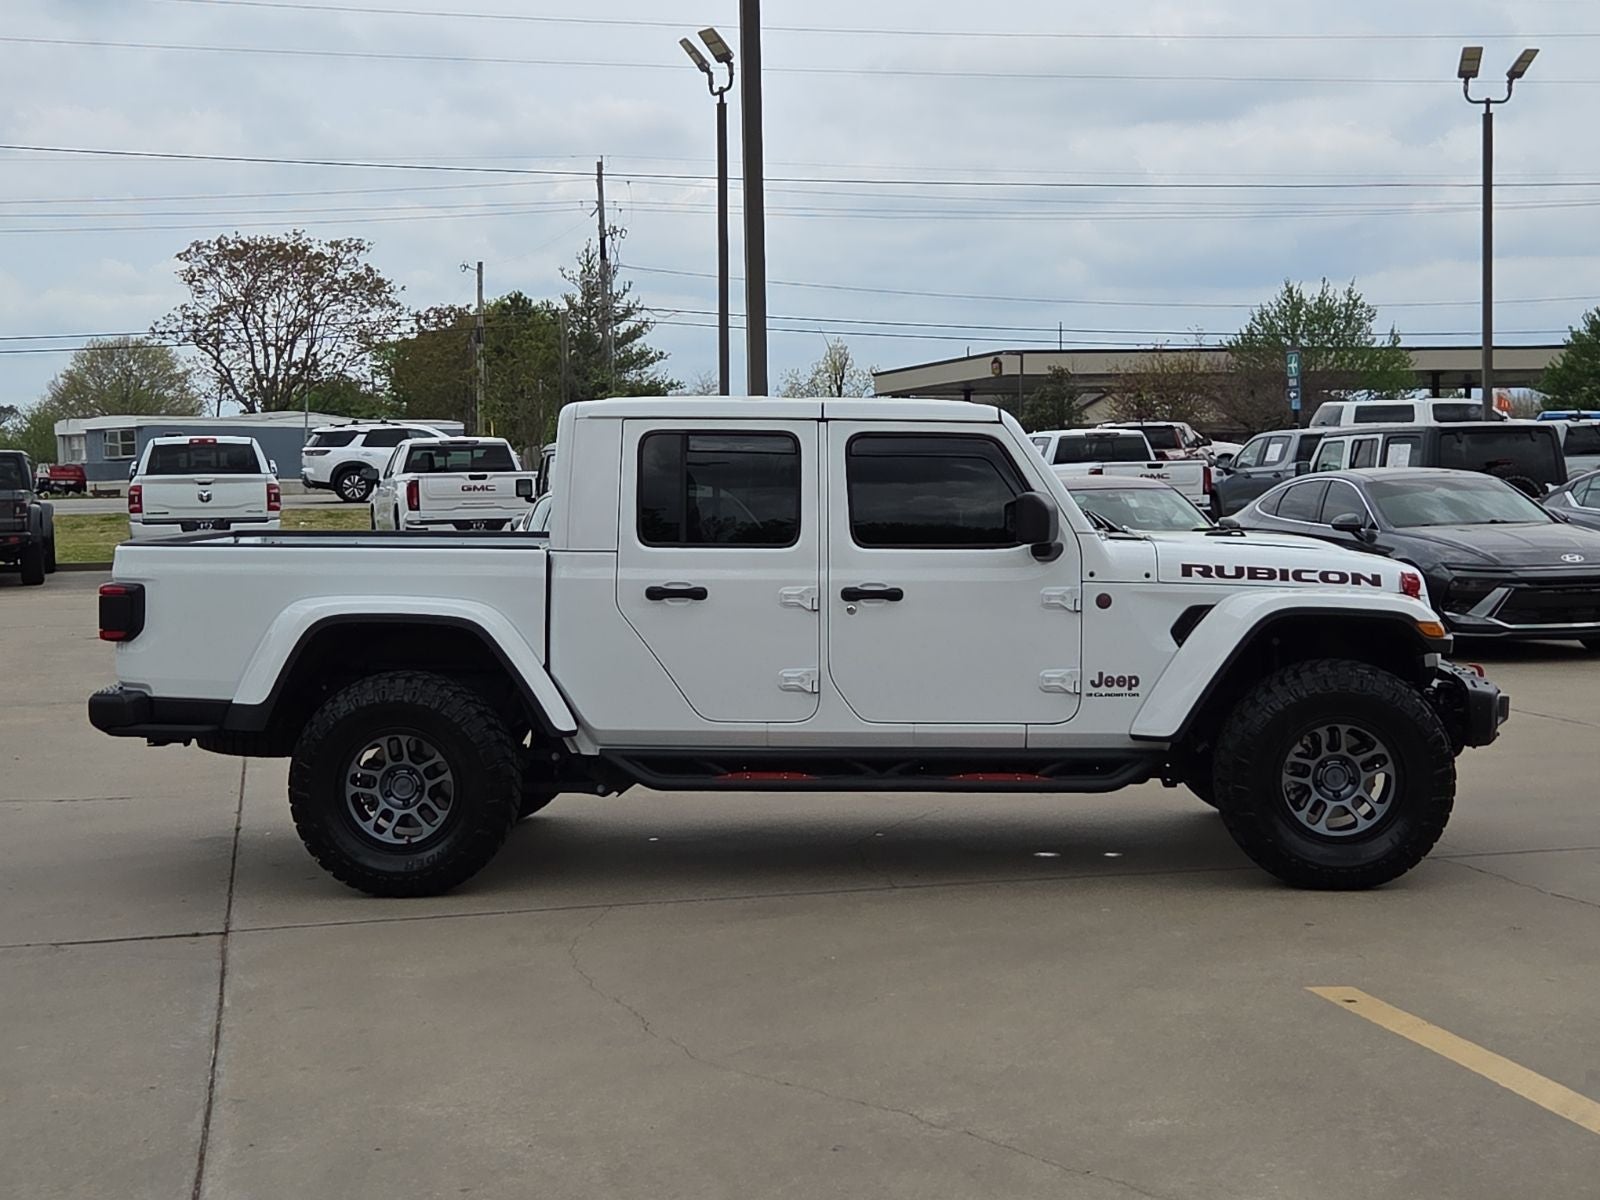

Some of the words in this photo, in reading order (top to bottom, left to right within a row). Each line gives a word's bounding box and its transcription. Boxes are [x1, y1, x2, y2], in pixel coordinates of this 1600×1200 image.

[461, 484, 496, 492] GMC
[1181, 563, 1382, 587] RUBICON
[1090, 671, 1140, 691] Jeep
